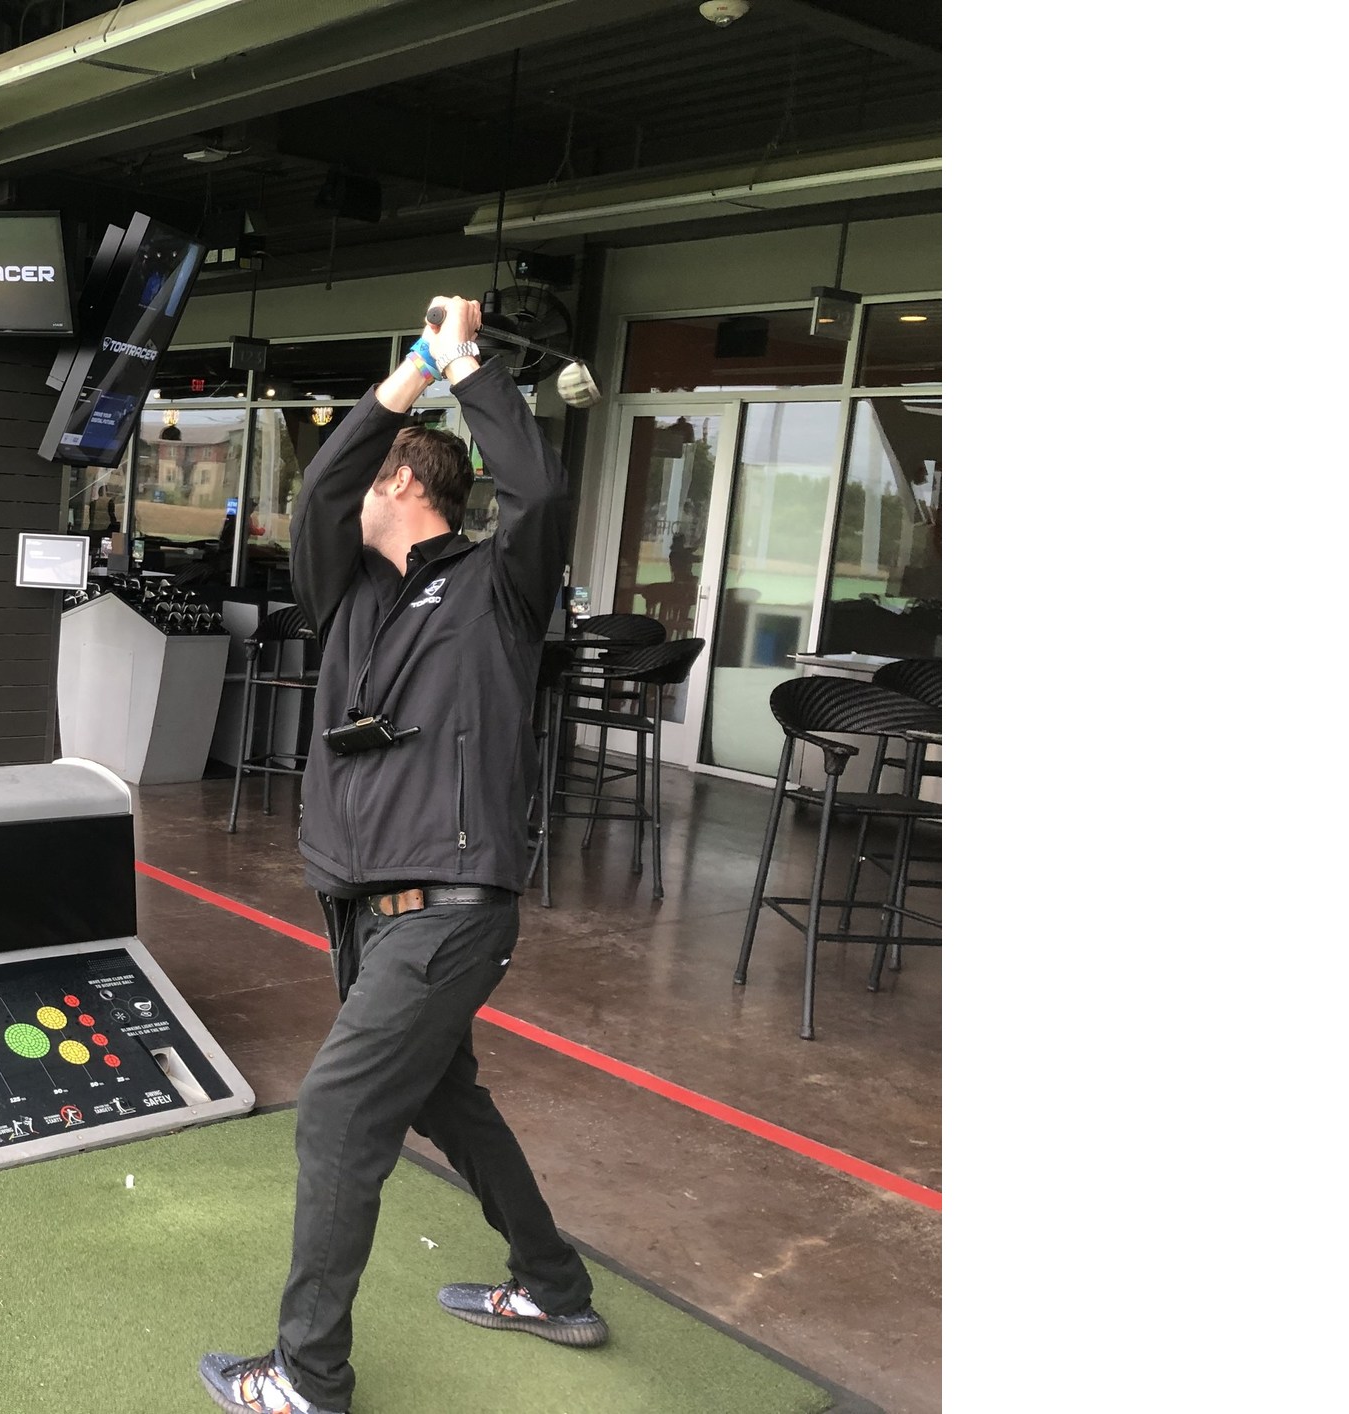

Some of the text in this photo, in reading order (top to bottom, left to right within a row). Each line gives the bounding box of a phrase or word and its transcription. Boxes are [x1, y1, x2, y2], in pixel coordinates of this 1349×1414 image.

[110, 340, 158, 360] TOPTRACER
[143, 1094, 173, 1107] SAFELY
[144, 1090, 163, 1098] SWING
